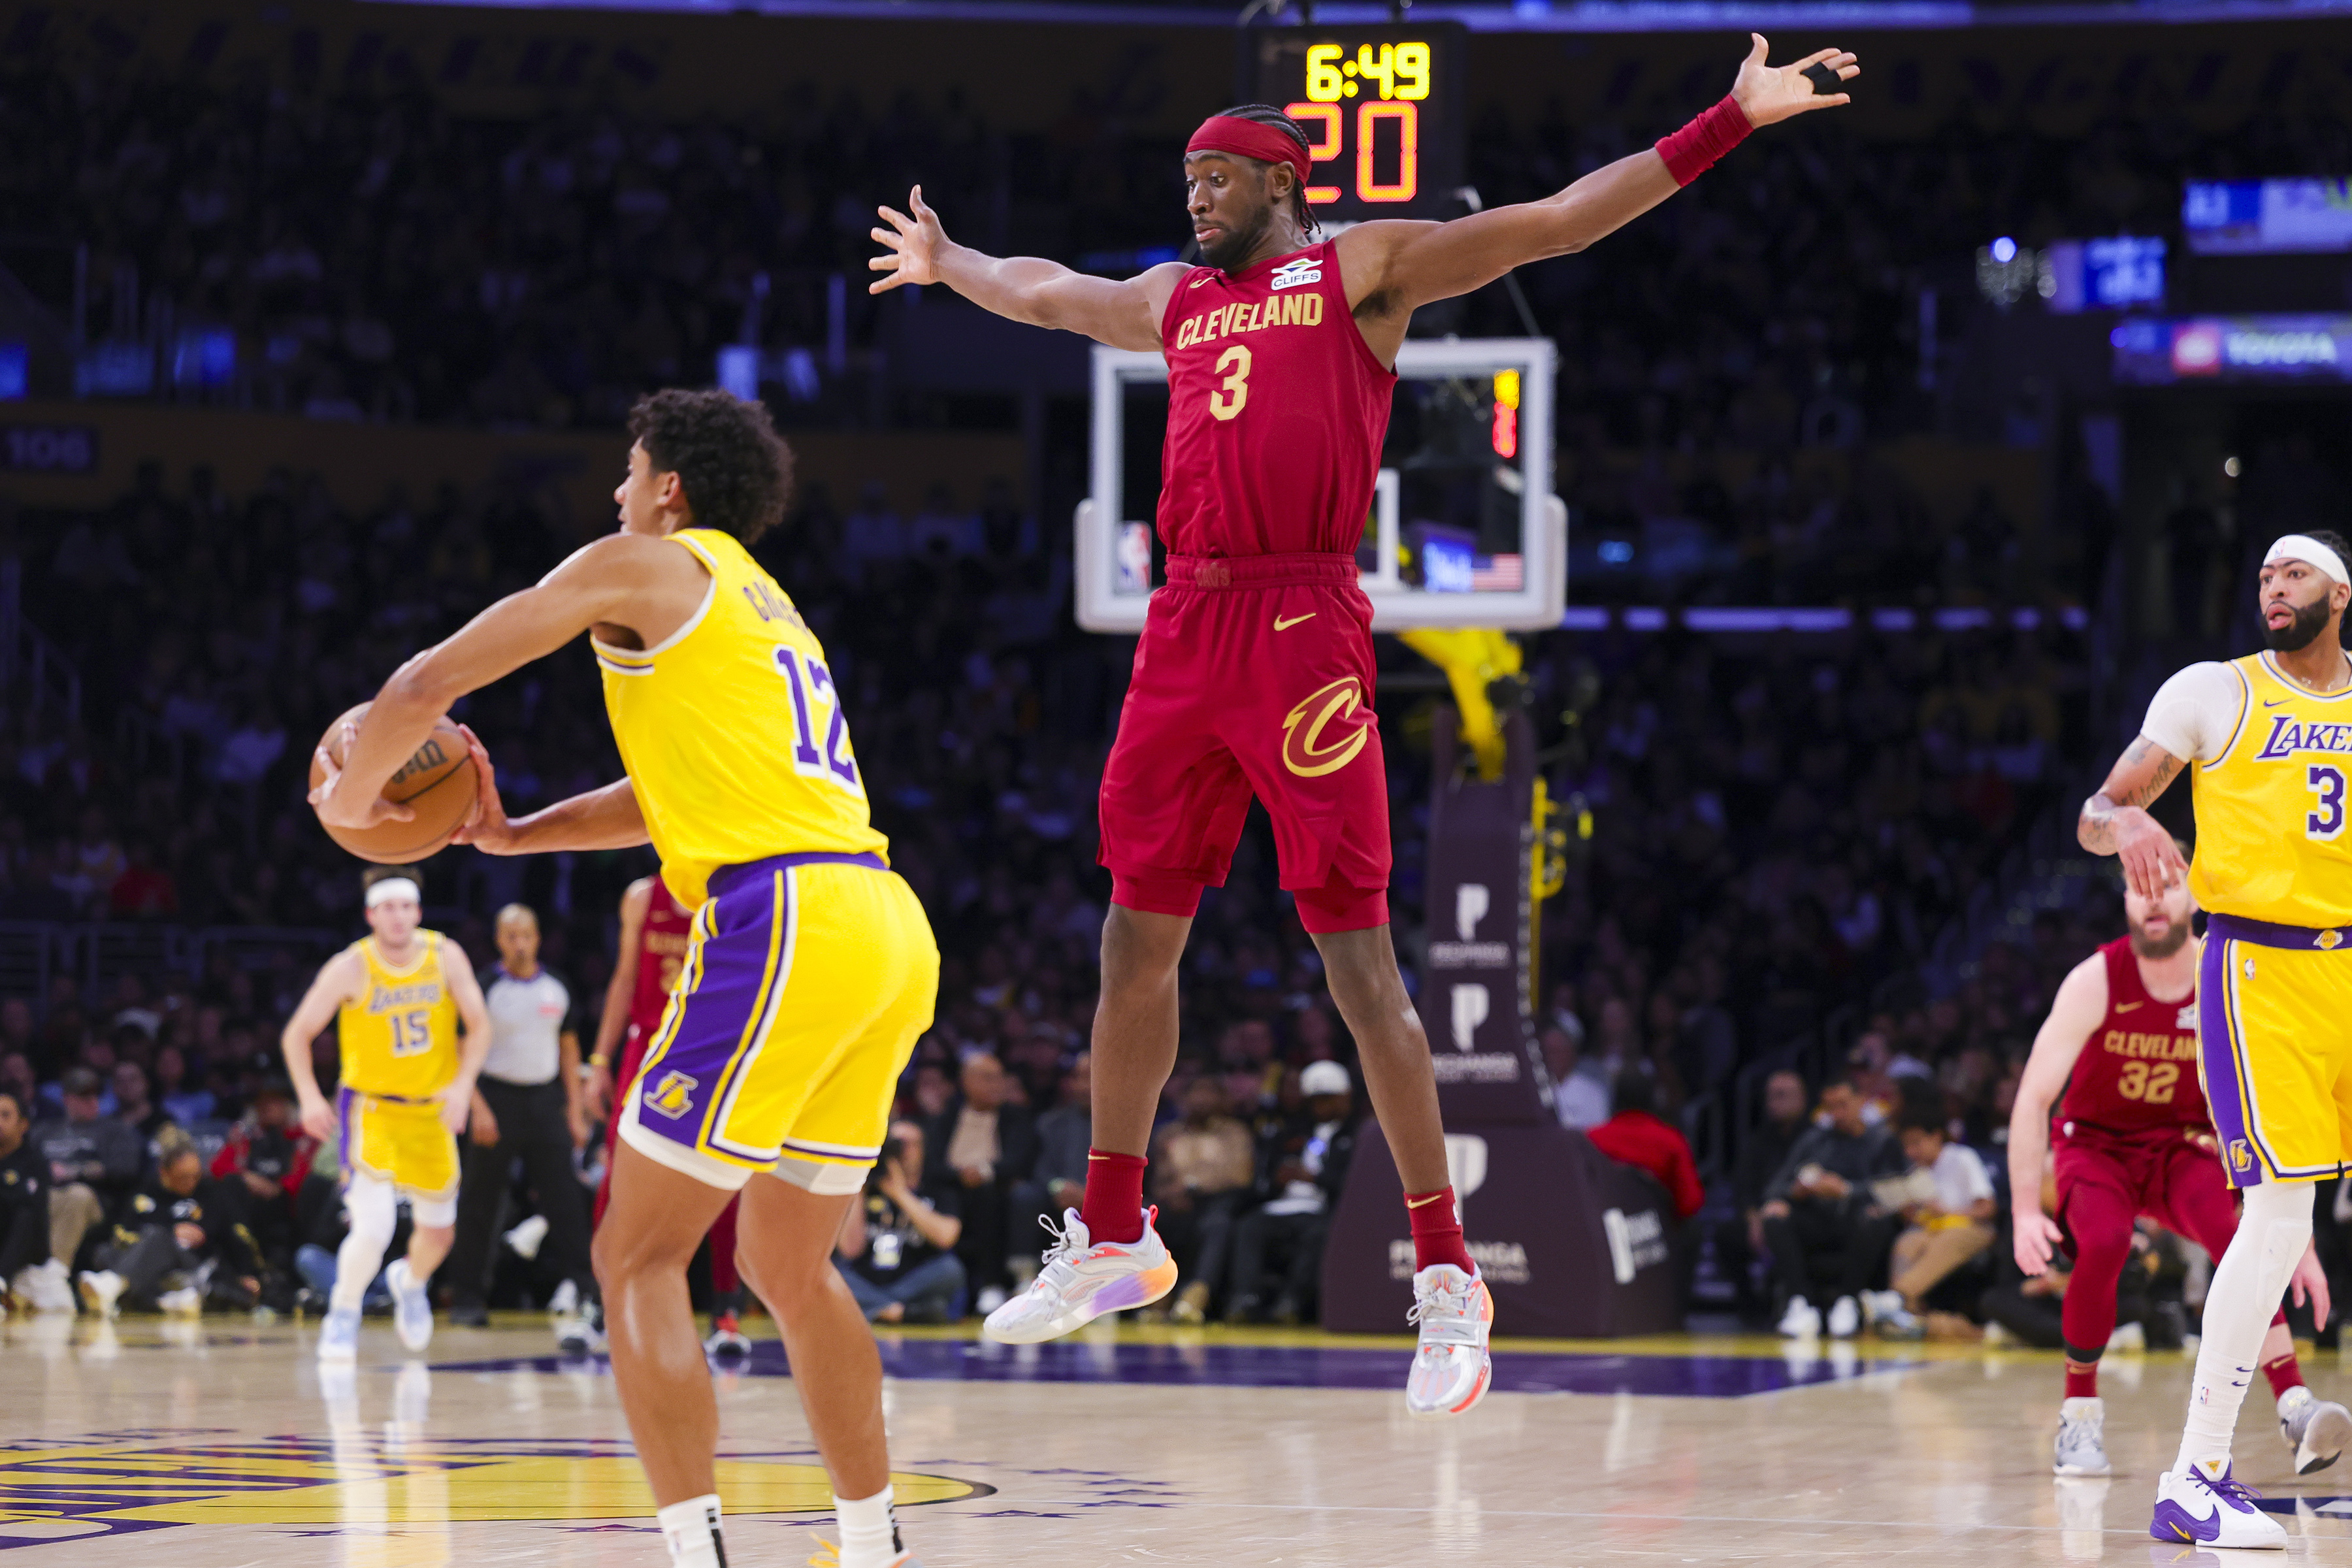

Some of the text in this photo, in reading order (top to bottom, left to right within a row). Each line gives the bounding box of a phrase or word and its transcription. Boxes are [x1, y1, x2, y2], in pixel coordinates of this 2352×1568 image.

[1306, 42, 1430, 102] 6:49
[1283, 101, 1418, 203] 20
[1273, 272, 1320, 287] CLIFFS
[1176, 293, 1324, 351] CLEVELAND
[1209, 344, 1252, 421] 3
[774, 644, 862, 795] 12
[2255, 715, 2352, 760] LAKE
[2308, 766, 2345, 838] 3
[391, 1009, 431, 1053] 15
[2104, 1030, 2197, 1062] CLEVELAN
[2117, 1060, 2181, 1105] 32
